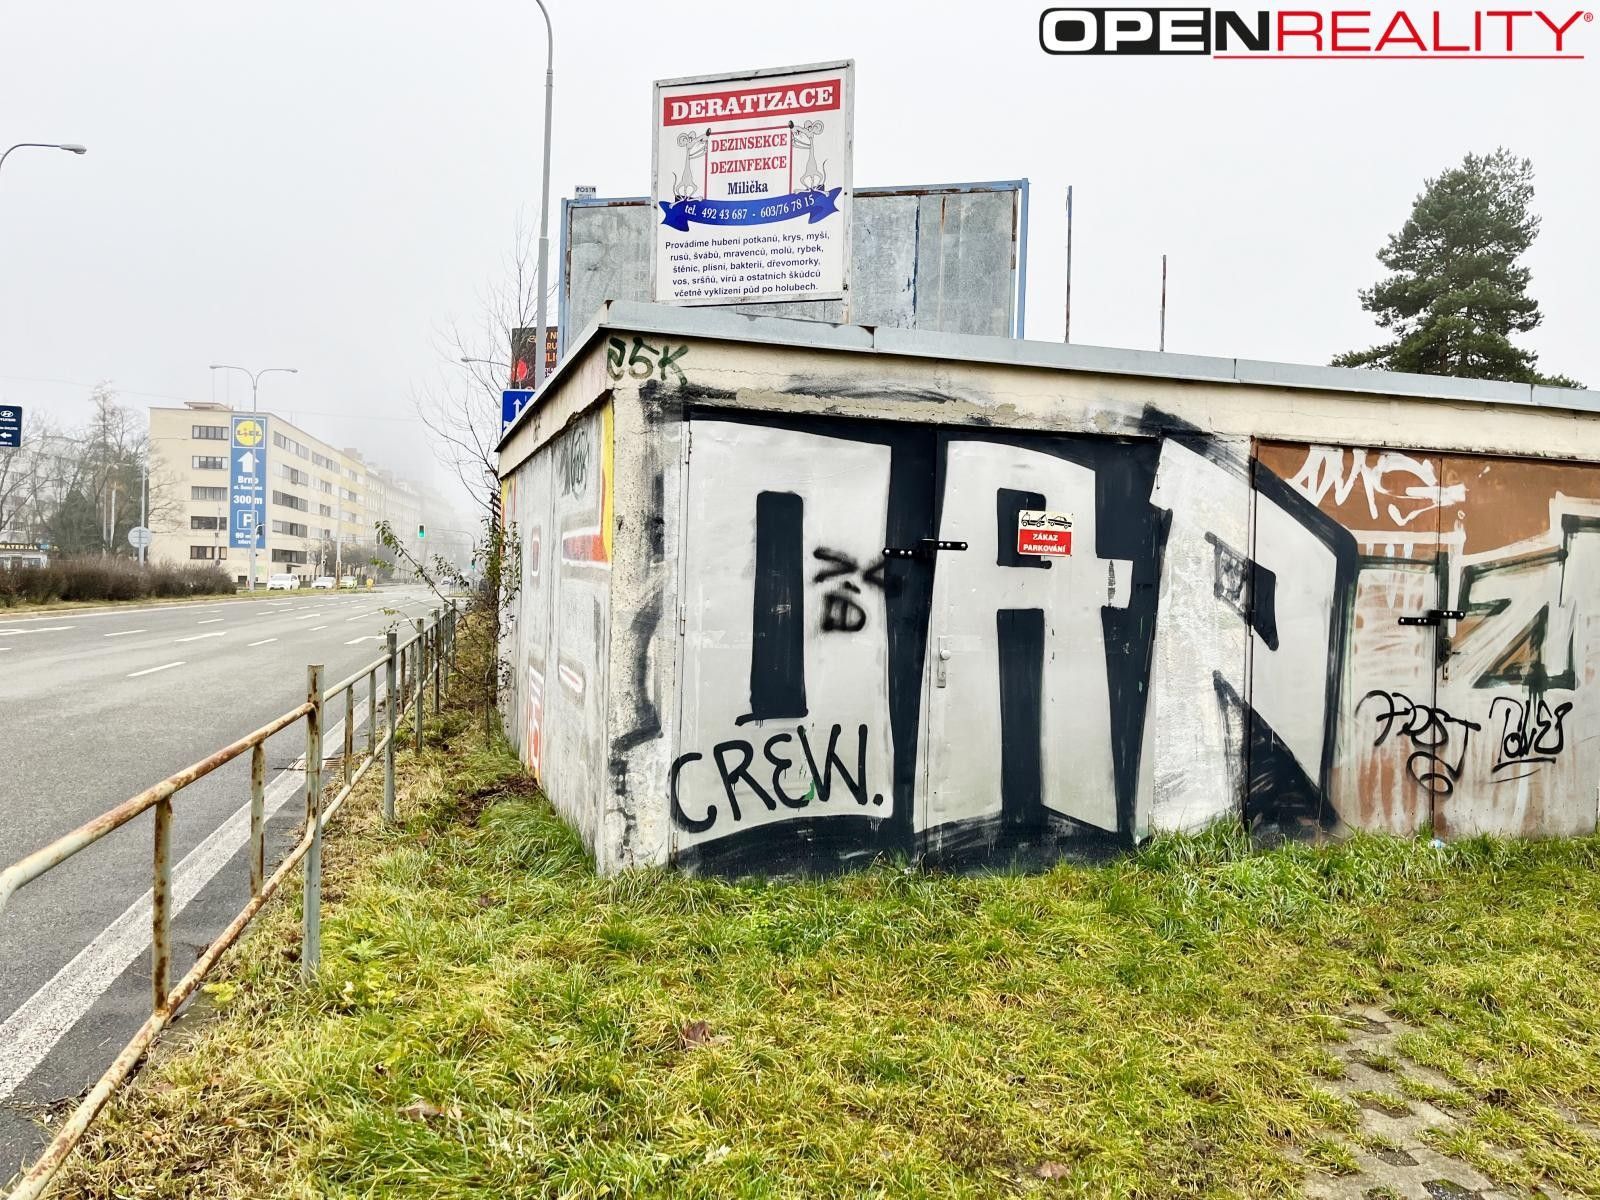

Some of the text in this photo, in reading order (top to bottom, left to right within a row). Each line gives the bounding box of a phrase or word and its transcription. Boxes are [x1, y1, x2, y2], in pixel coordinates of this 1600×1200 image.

[671, 86, 834, 121] DERATIZACE
[711, 133, 788, 153] DEZINSEKCE
[710, 155, 787, 175] DEZINFEKCE
[727, 175, 769, 195] Milička
[684, 204, 697, 216] tel.
[702, 207, 717, 219] 492
[718, 209, 730, 220] 43
[731, 208, 748, 220] 687
[760, 203, 789, 218] 603/76
[791, 198, 802, 212] 78
[804, 194, 815, 207] 15
[665, 239, 710, 250] Provádíme
[711, 236, 741, 247] hubení
[782, 233, 804, 243] krys,
[672, 277, 690, 285] vos,
[746, 271, 786, 282] ostatních
[674, 288, 702, 297] včetně
[762, 285, 773, 294] po
[233, 495, 252, 505] 300
[1032, 533, 1059, 542] ZÁKAZ
[1023, 544, 1067, 553] PARKOVÁNÍ
